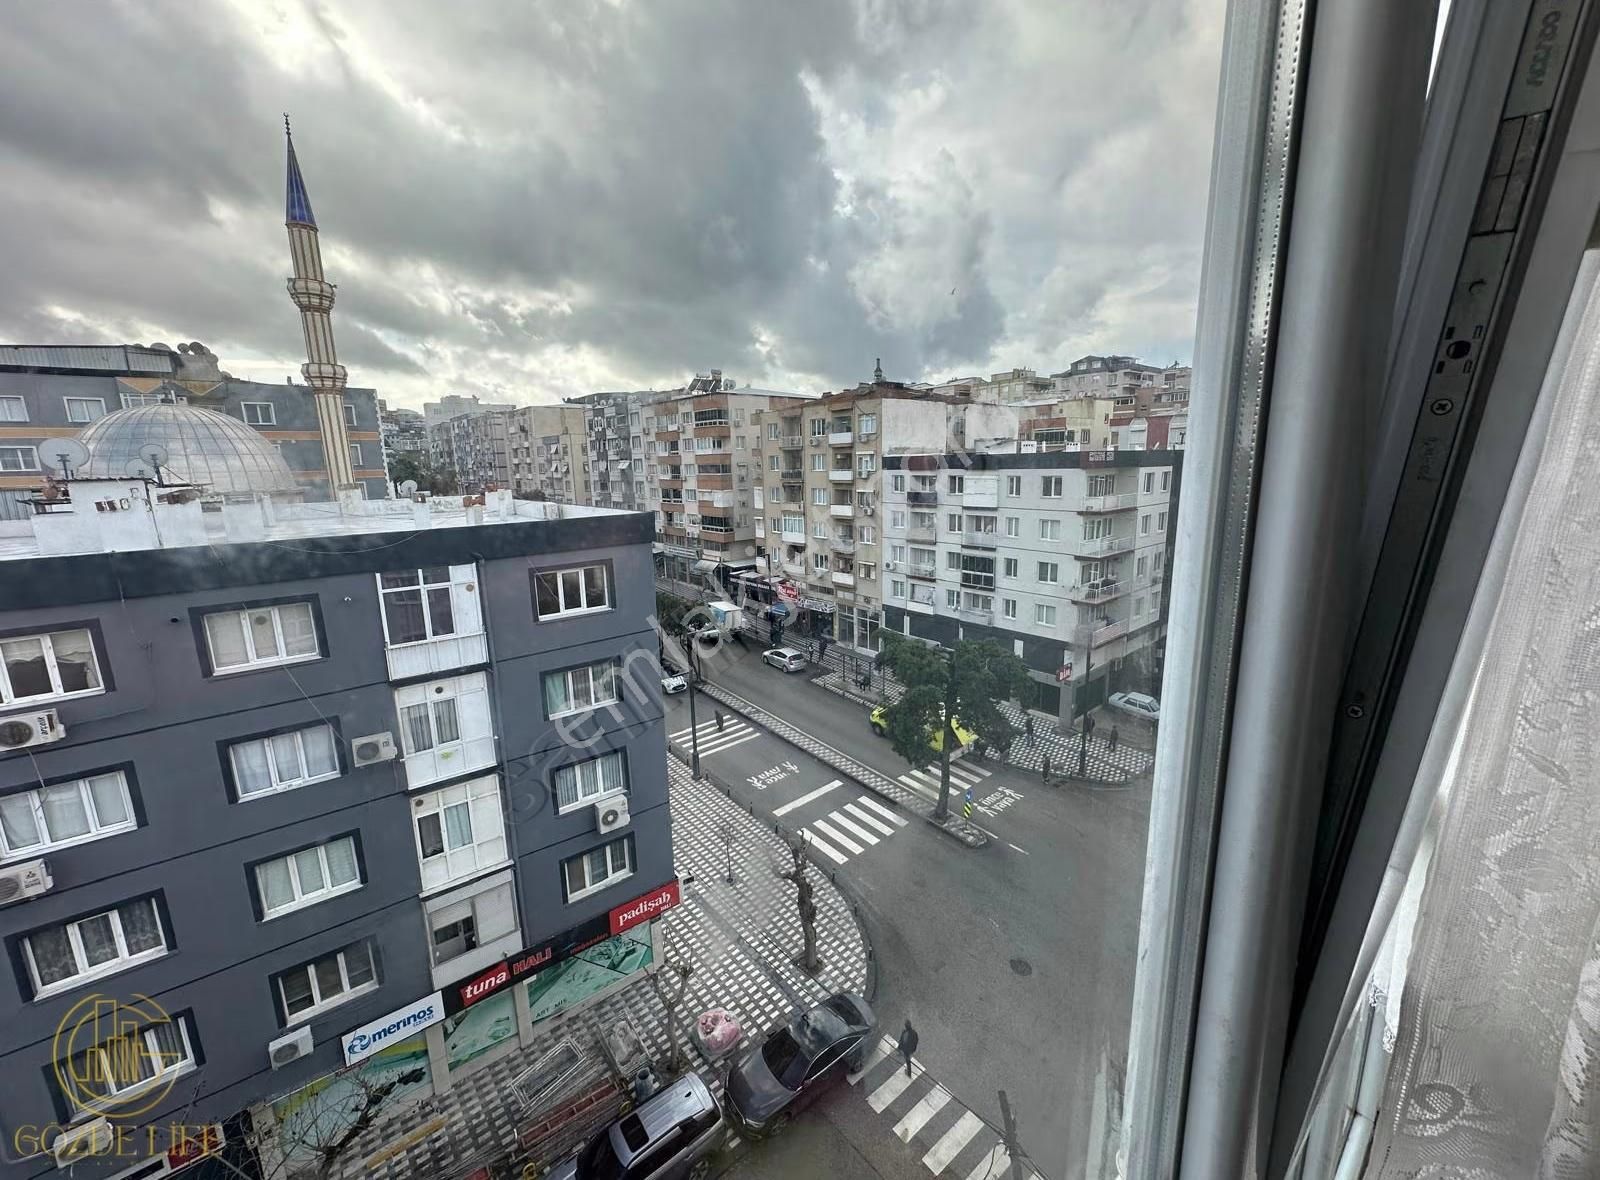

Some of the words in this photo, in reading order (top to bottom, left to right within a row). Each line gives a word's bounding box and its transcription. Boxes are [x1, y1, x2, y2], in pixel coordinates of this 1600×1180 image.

[618, 891, 671, 927] padişah
[464, 969, 507, 999] tuna
[512, 947, 552, 975] HALI
[371, 1005, 434, 1043] merinos
